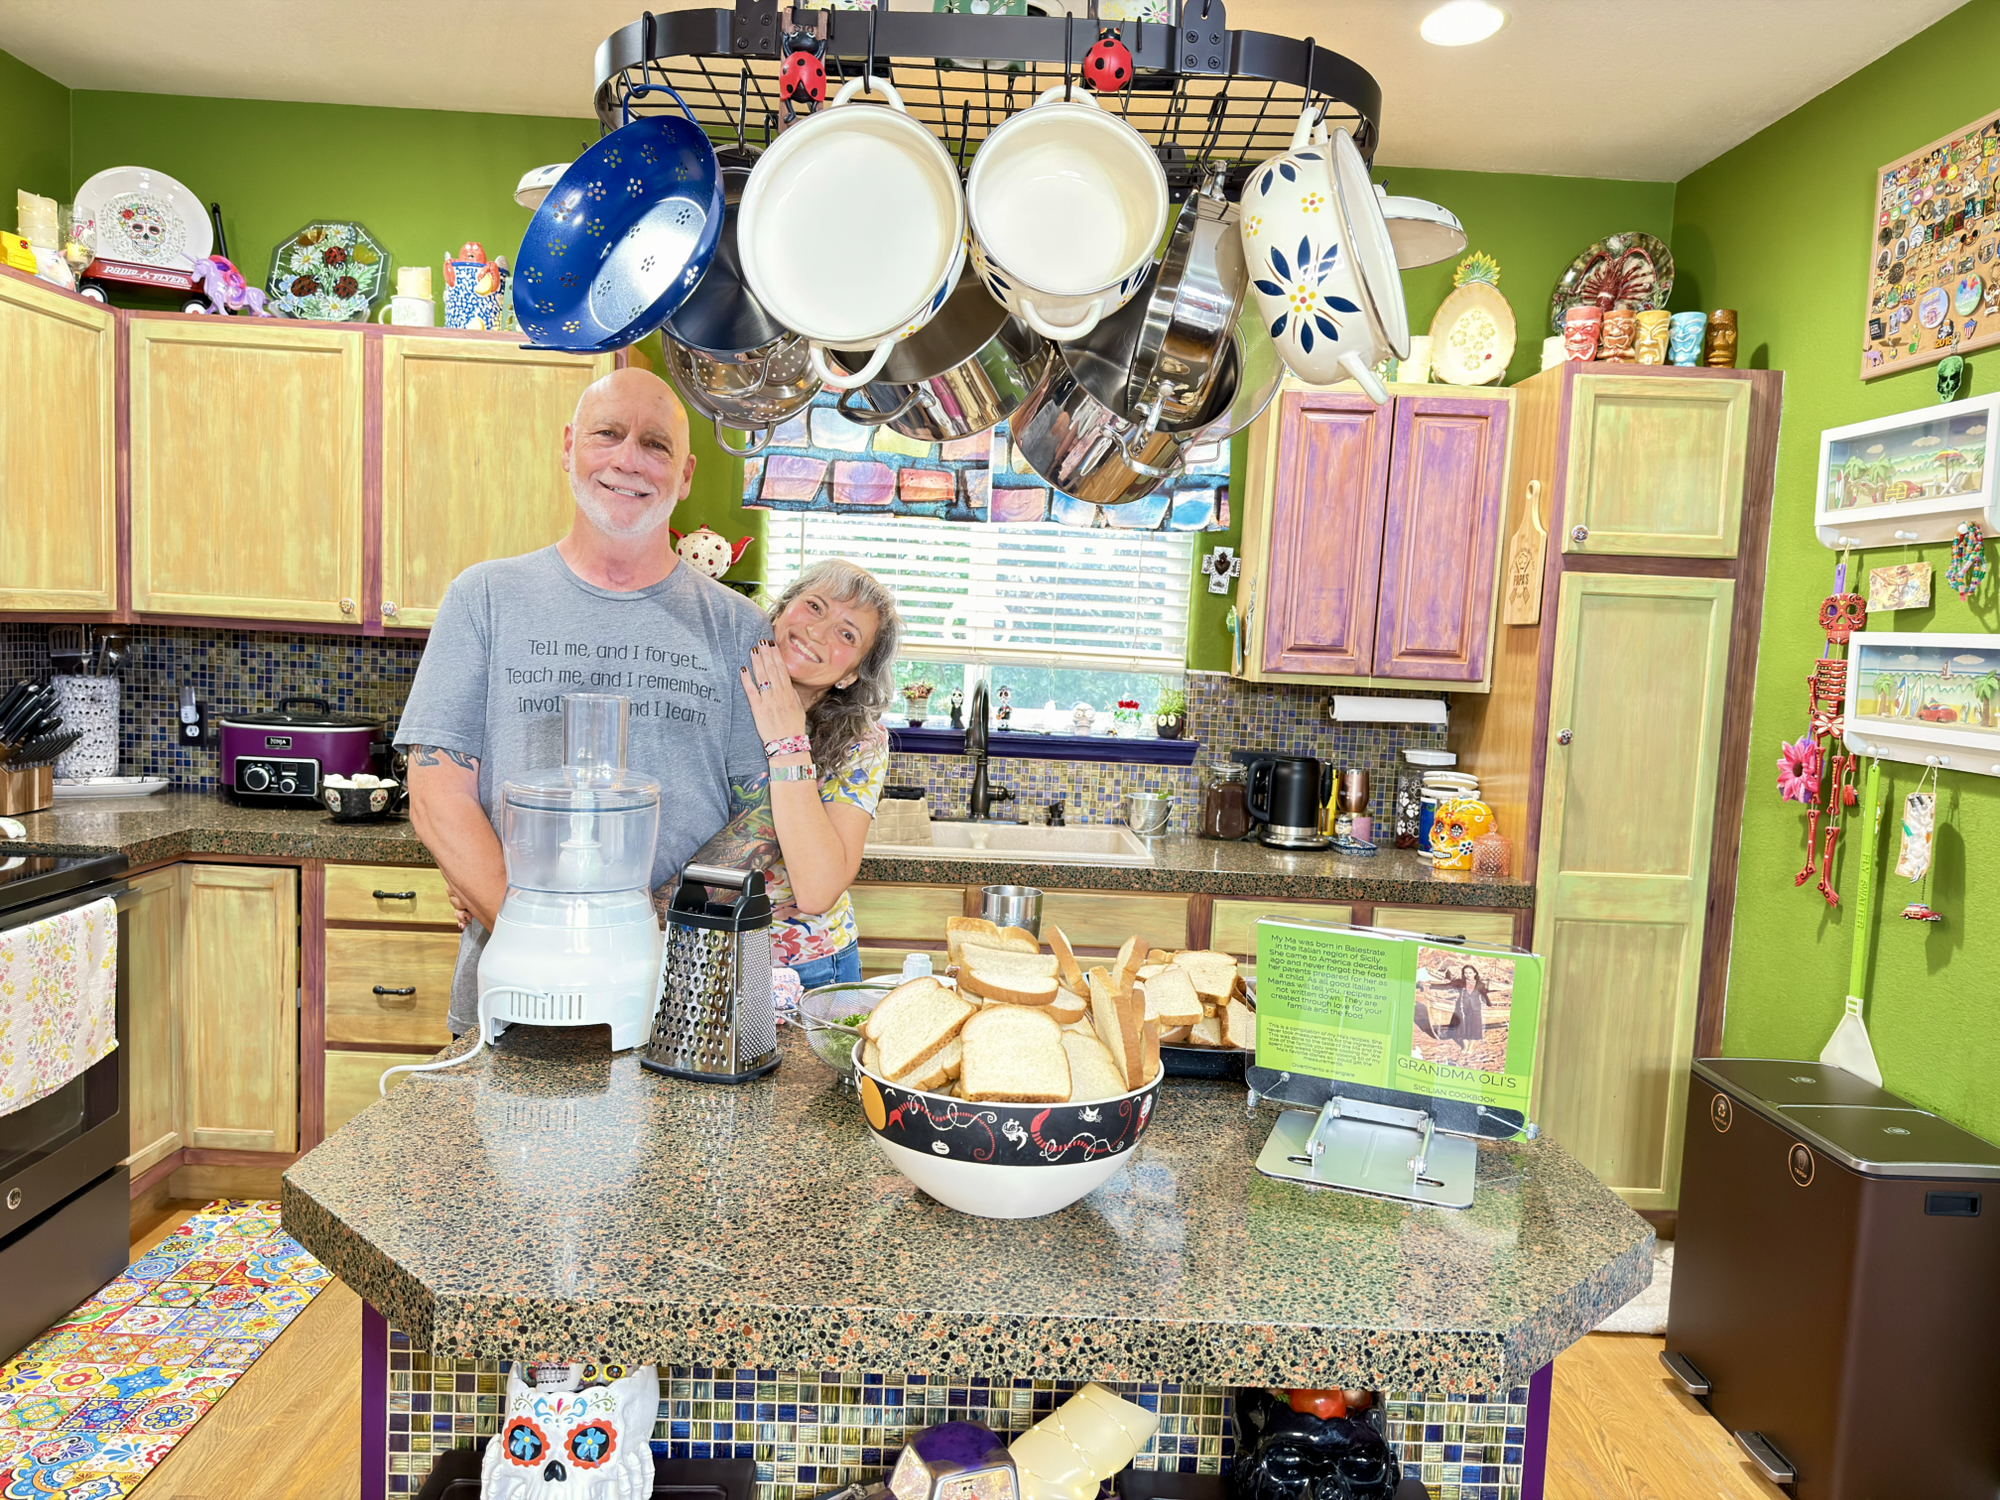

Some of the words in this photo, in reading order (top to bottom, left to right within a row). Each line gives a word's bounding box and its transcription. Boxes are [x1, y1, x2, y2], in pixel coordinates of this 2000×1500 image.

[103, 265, 137, 276] RADIO
[1513, 574, 1529, 586] PAPA'S
[528, 639, 558, 656] Tell
[564, 643, 591, 659] me,
[596, 645, 627, 660] and
[633, 645, 639, 659] I
[645, 646, 708, 672] forget...
[505, 667, 553, 684] Teach
[559, 670, 585, 686] me,
[590, 671, 621, 686] and
[627, 672, 633, 687] I
[638, 674, 721, 704] remember...
[518, 696, 565, 713] Invol
[629, 703, 649, 717] nd
[654, 701, 660, 716] I
[666, 702, 707, 727] learn.
[1862, 853, 1870, 875] FLY
[1856, 880, 1868, 929] SWATTER
[1272, 935, 1283, 944] My
[1316, 941, 1334, 949] born
[1269, 949, 1284, 957] She
[1286, 952, 1308, 960] came
[1320, 956, 1352, 966] America
[1353, 961, 1388, 972] decades
[1298, 946, 1321, 954] Italian
[1323, 950, 1348, 958] region
[1282, 966, 1311, 975] parents
[1312, 970, 1348, 981] prepared
[1326, 964, 1350, 974] forgot
[1368, 970, 1386, 979] food
[1268, 977, 1296, 986] Mamas
[1344, 990, 1372, 998] recipes
[1330, 980, 1350, 988] good
[1352, 983, 1376, 992] Italian
[1270, 993, 1300, 1002] created
[1302, 997, 1332, 1008] through
[1334, 1002, 1350, 1010] love
[1344, 996, 1364, 1006] They
[1398, 1057, 1475, 1082] GRANDMA
[1479, 1074, 1517, 1088] OLI'S
[1413, 1084, 1447, 1096] SICILIAN
[1448, 1090, 1496, 1104] COOKBOOK
